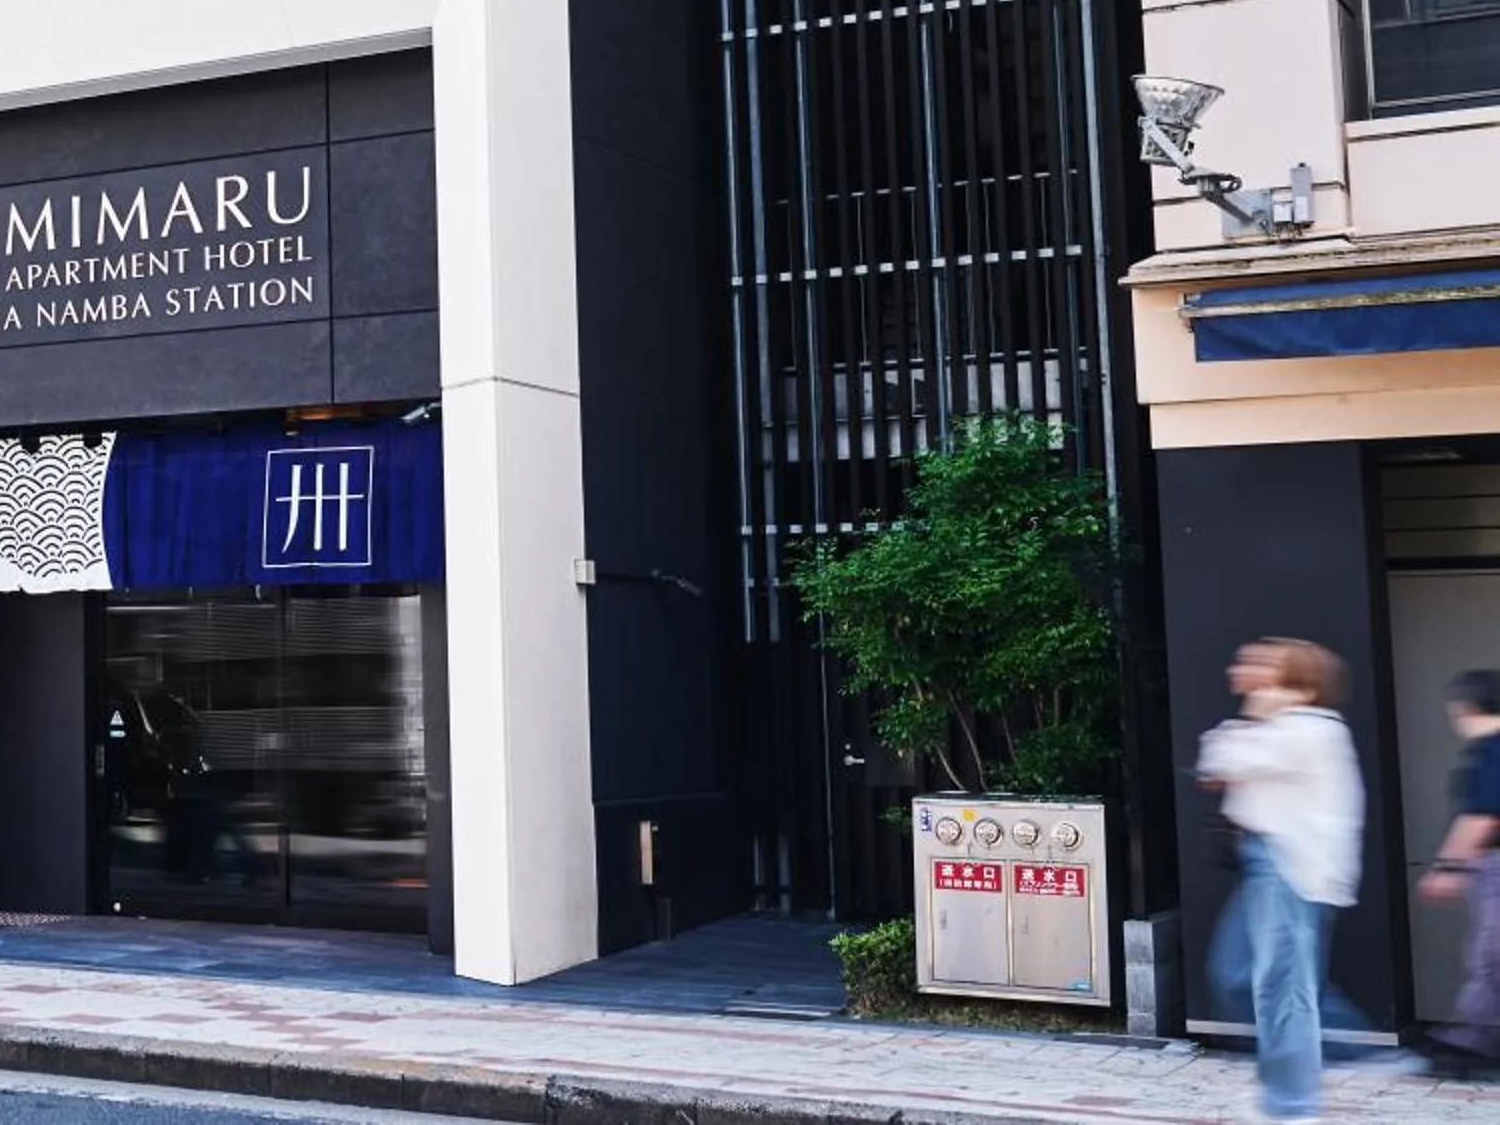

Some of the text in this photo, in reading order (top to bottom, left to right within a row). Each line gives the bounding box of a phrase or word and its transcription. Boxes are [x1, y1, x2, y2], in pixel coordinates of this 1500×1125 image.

[4, 166, 312, 255] MIMARU
[5, 236, 313, 291] APARTMENT HOTEL
[36, 291, 151, 327] NAMBA
[165, 276, 314, 316] STATION
